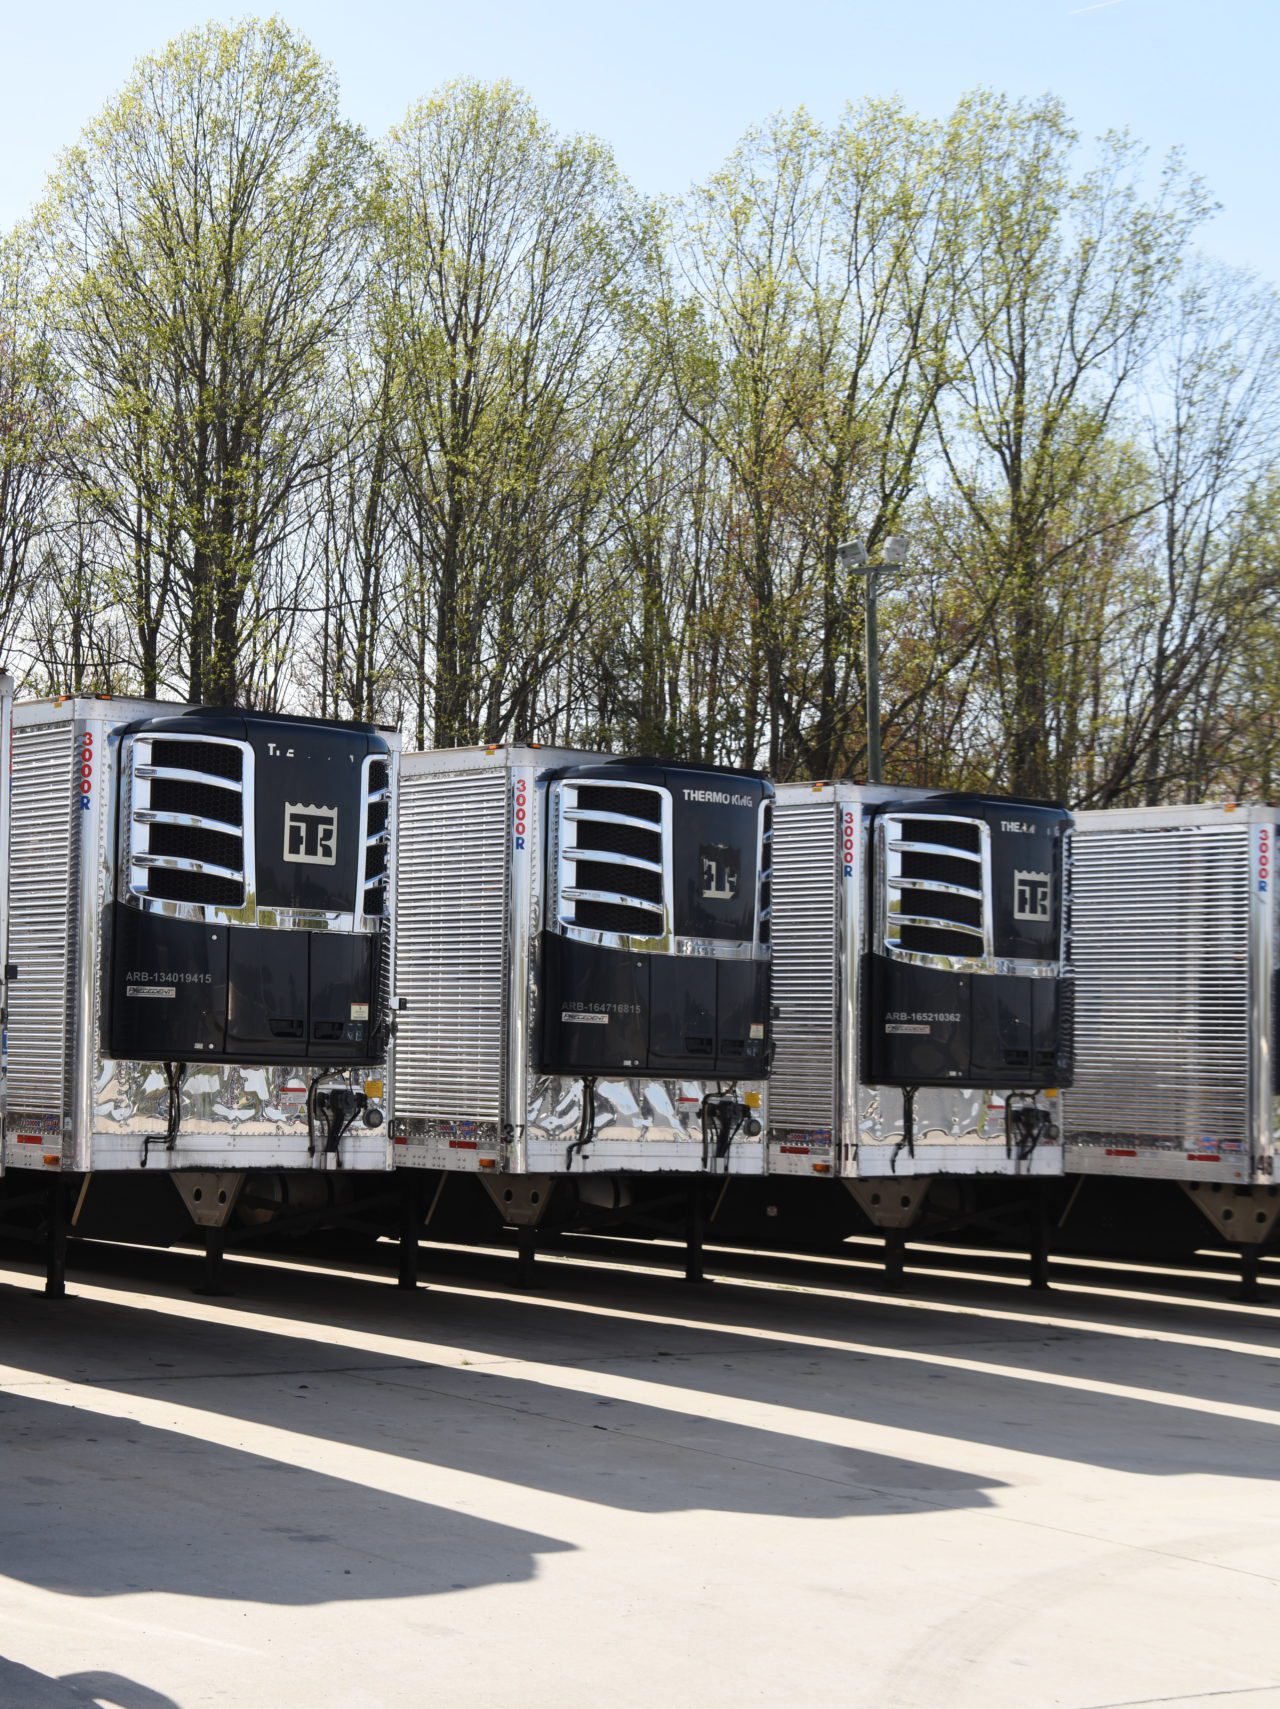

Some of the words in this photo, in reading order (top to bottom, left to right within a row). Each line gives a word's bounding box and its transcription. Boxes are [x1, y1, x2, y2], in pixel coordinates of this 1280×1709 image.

[80, 731, 94, 811] 3000R
[683, 789, 730, 805] THERMO
[731, 794, 753, 808] KING
[515, 778, 527, 851] 3000R
[843, 811, 854, 878] 3000R
[1258, 828, 1269, 893] 3000R
[125, 971, 213, 984] ARB-134019415
